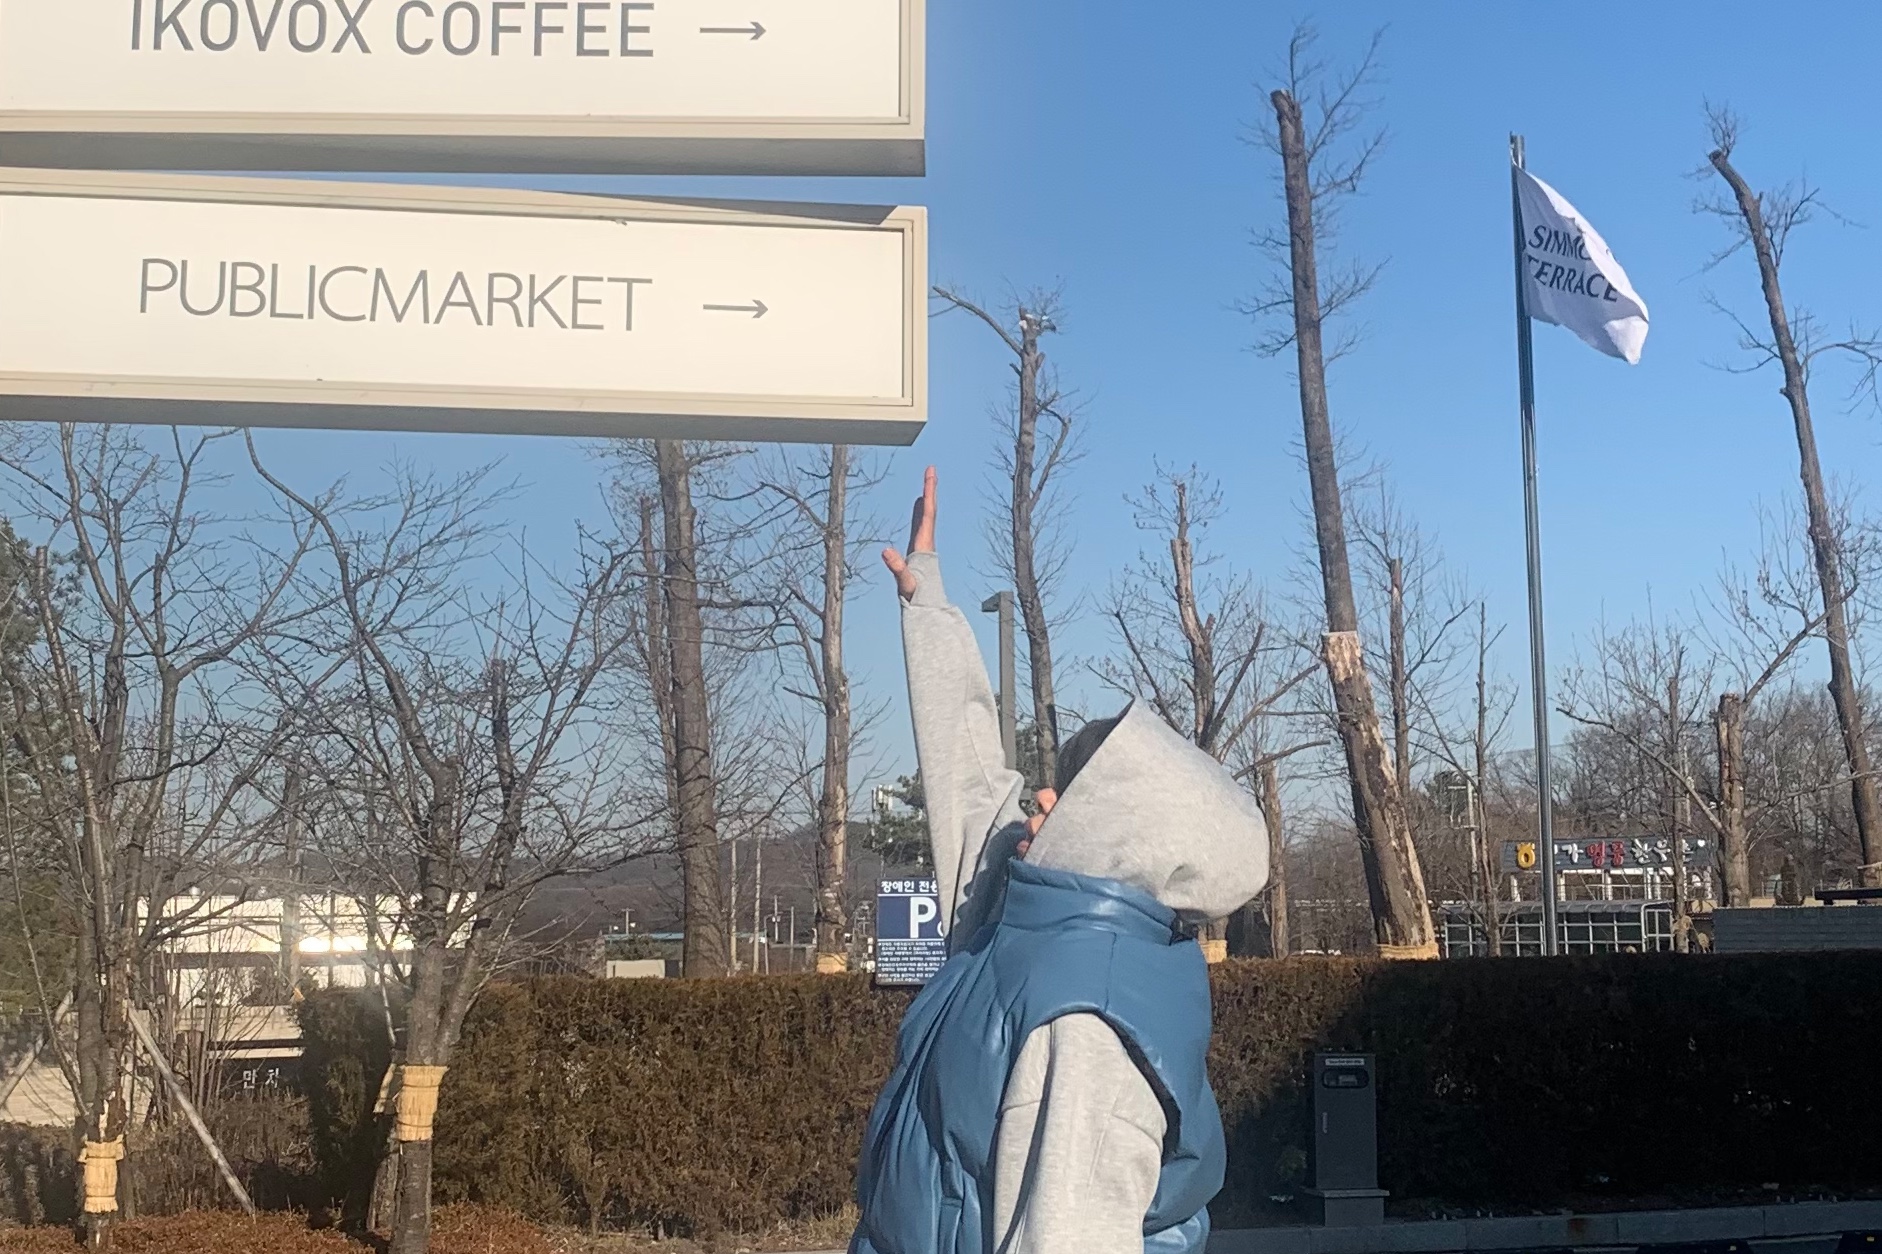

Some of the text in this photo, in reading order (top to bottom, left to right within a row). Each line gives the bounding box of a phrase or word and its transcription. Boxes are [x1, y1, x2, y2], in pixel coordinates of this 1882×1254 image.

[130, 0, 655, 57] IKOVOX COFFEE
[139, 257, 655, 332] PUBLICMARKET
[881, 880, 915, 893] 장애인
[910, 896, 937, 939] P
